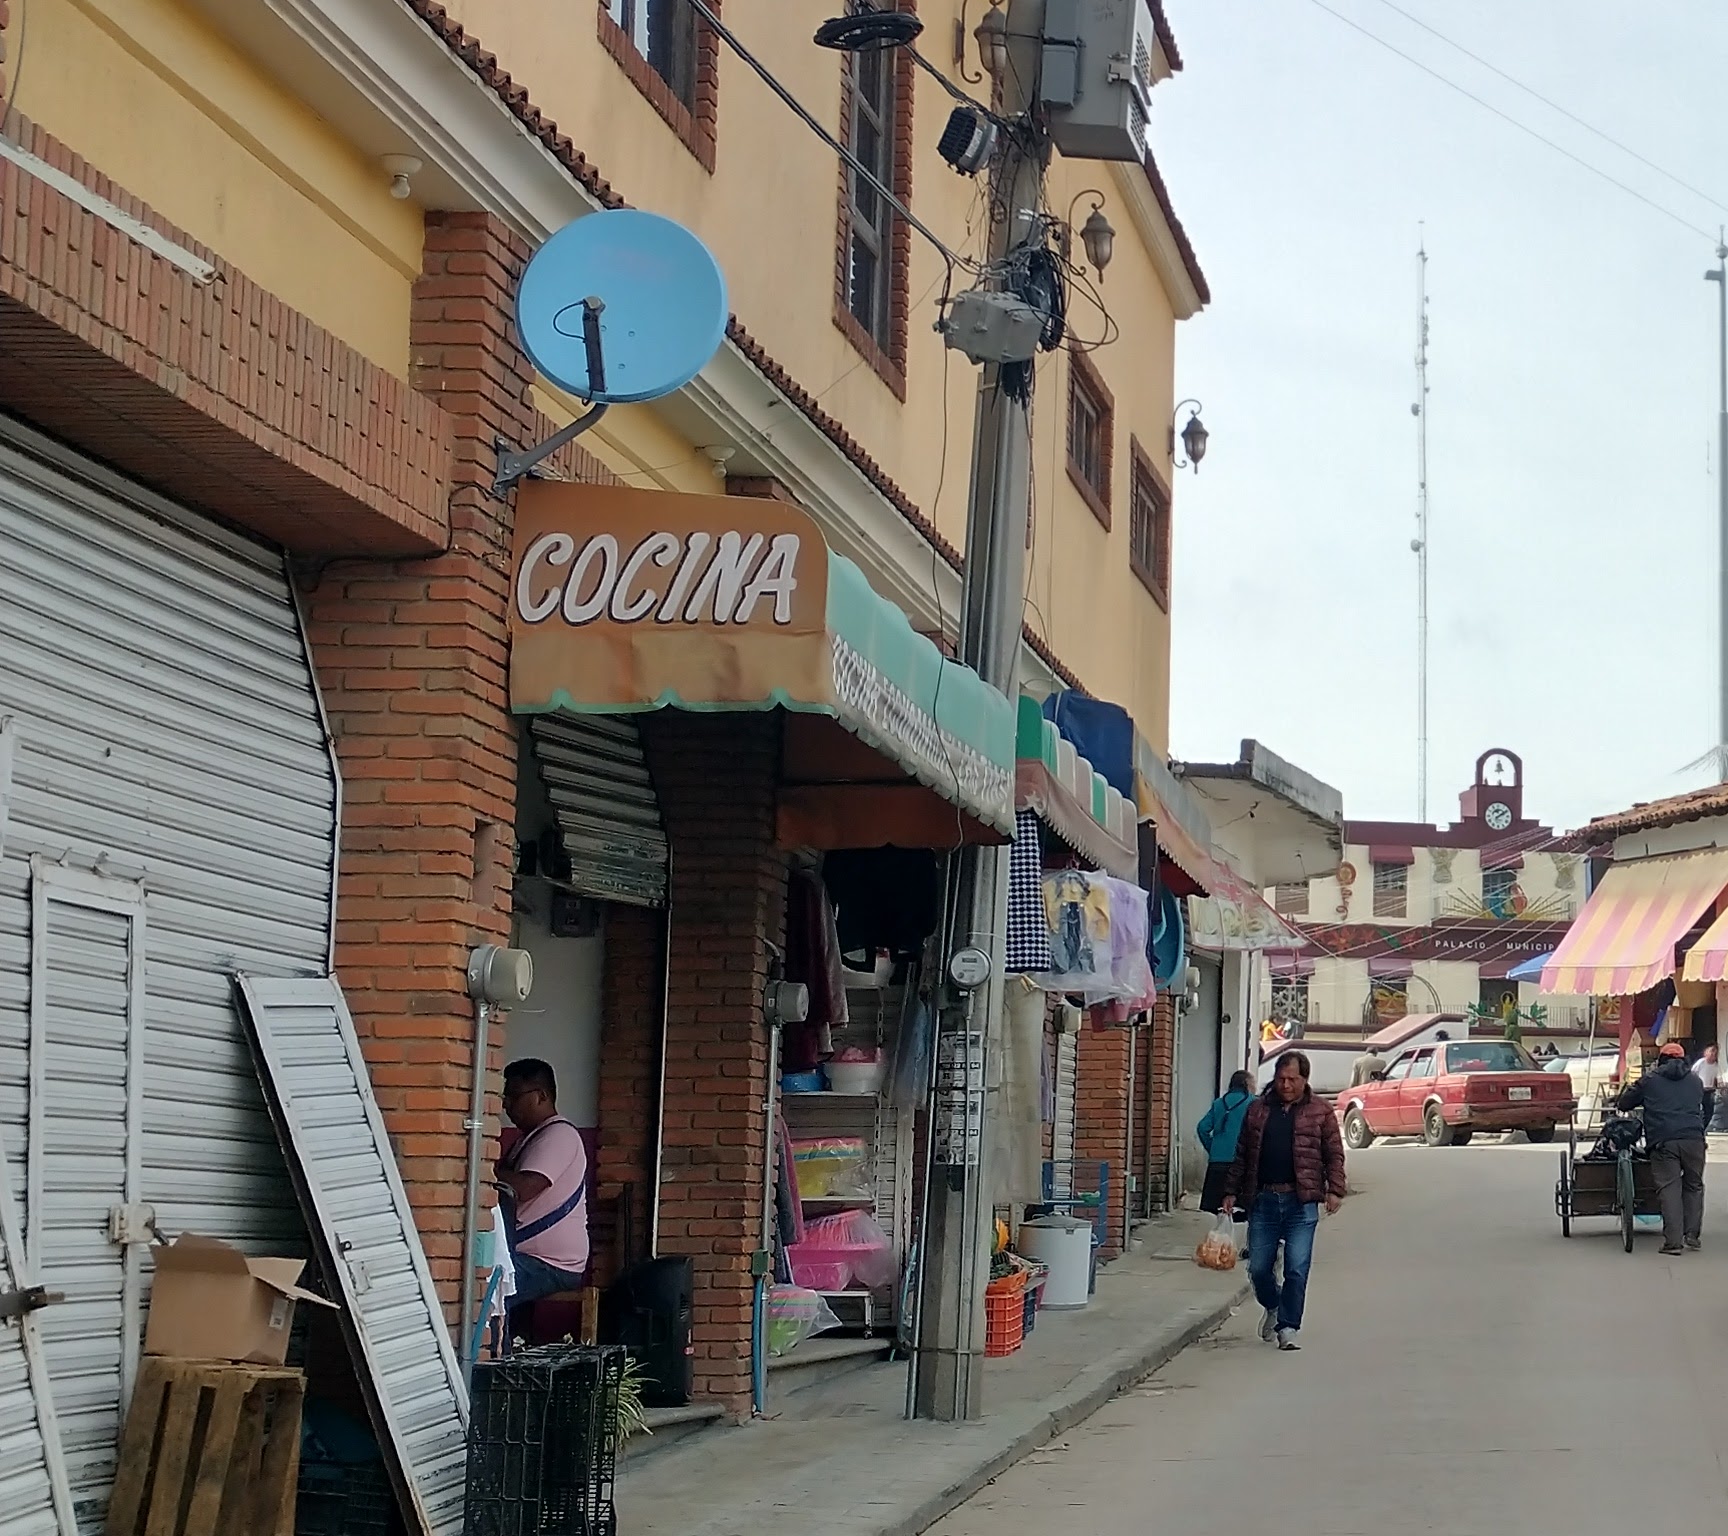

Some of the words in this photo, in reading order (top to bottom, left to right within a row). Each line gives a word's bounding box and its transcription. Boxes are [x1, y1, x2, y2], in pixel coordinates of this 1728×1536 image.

[516, 530, 800, 624] COCINA
[1435, 939, 1486, 949] PALACIO
[1506, 942, 1555, 951] MUNICIP
